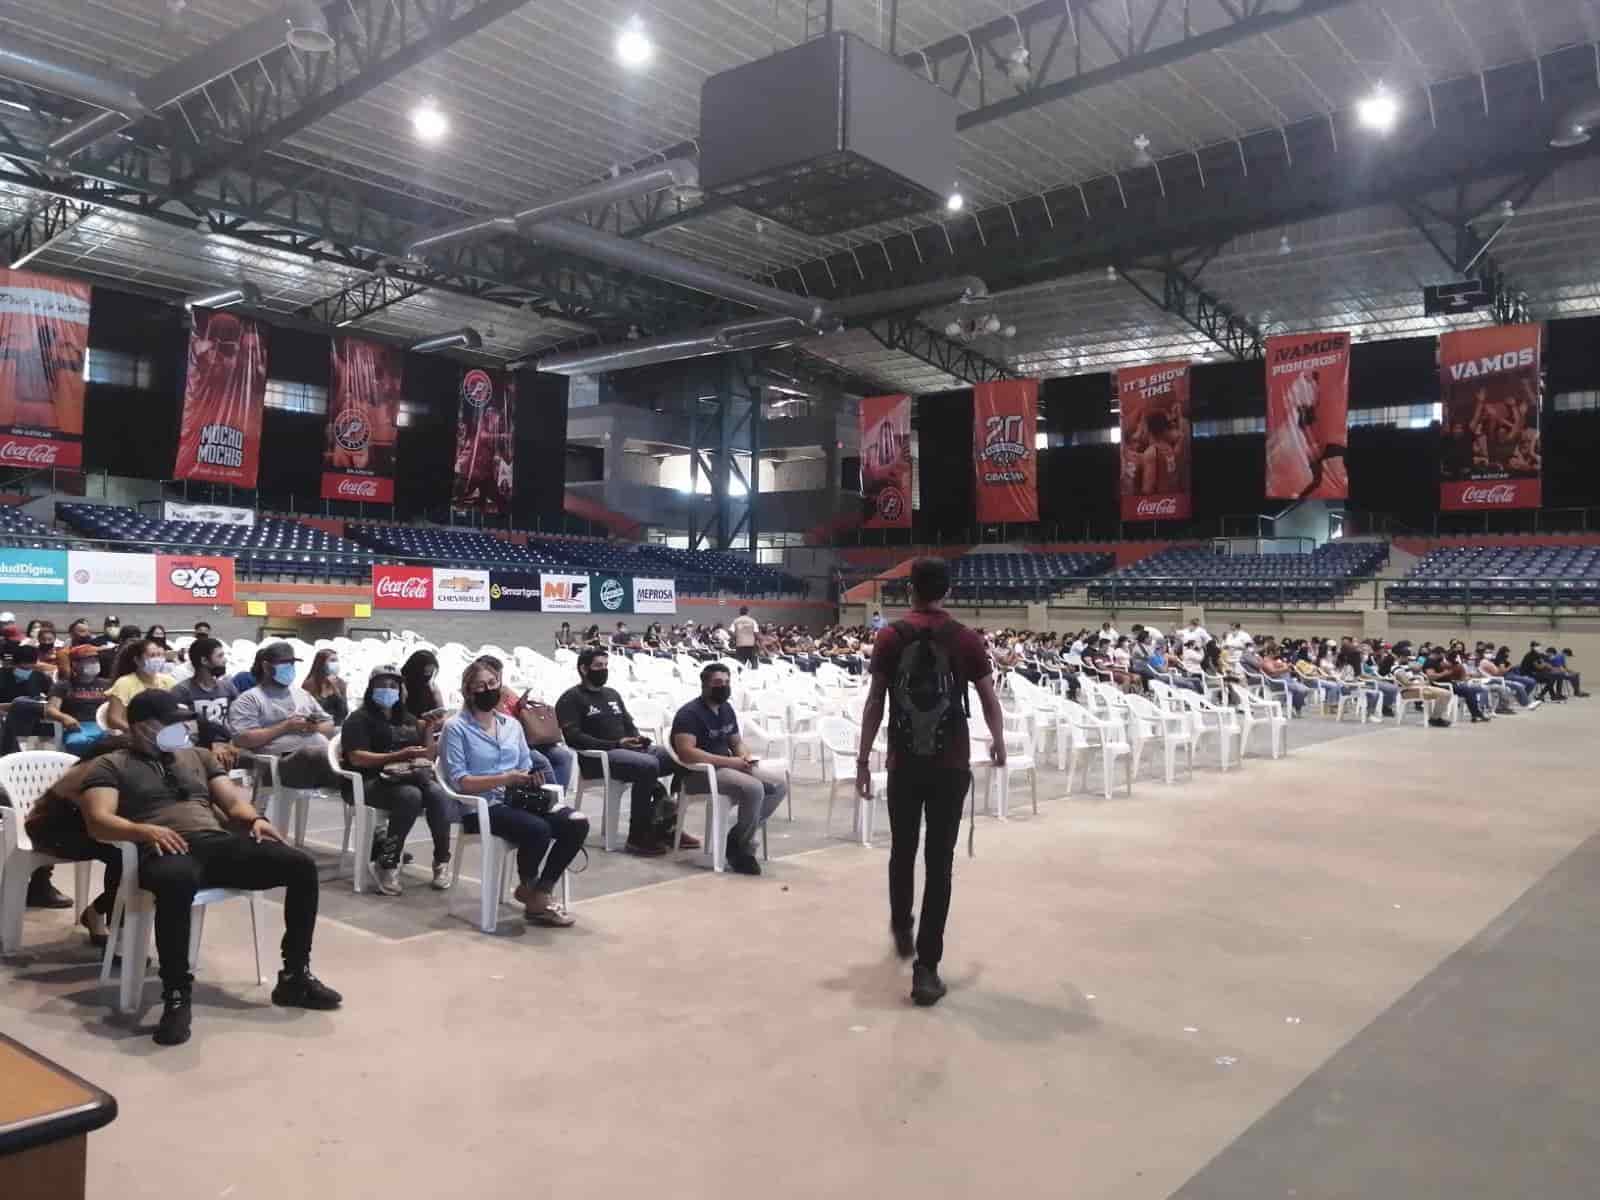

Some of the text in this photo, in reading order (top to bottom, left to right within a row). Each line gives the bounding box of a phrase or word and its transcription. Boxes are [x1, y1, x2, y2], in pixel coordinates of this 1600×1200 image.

[1450, 347, 1534, 380] VAMOS
[1150, 367, 1187, 384] SHOW
[1140, 383, 1170, 399] TIME
[197, 444, 242, 468] MOCHIS
[438, 595, 486, 604] CHEVROLET
[638, 588, 673, 600] MEPROSA
